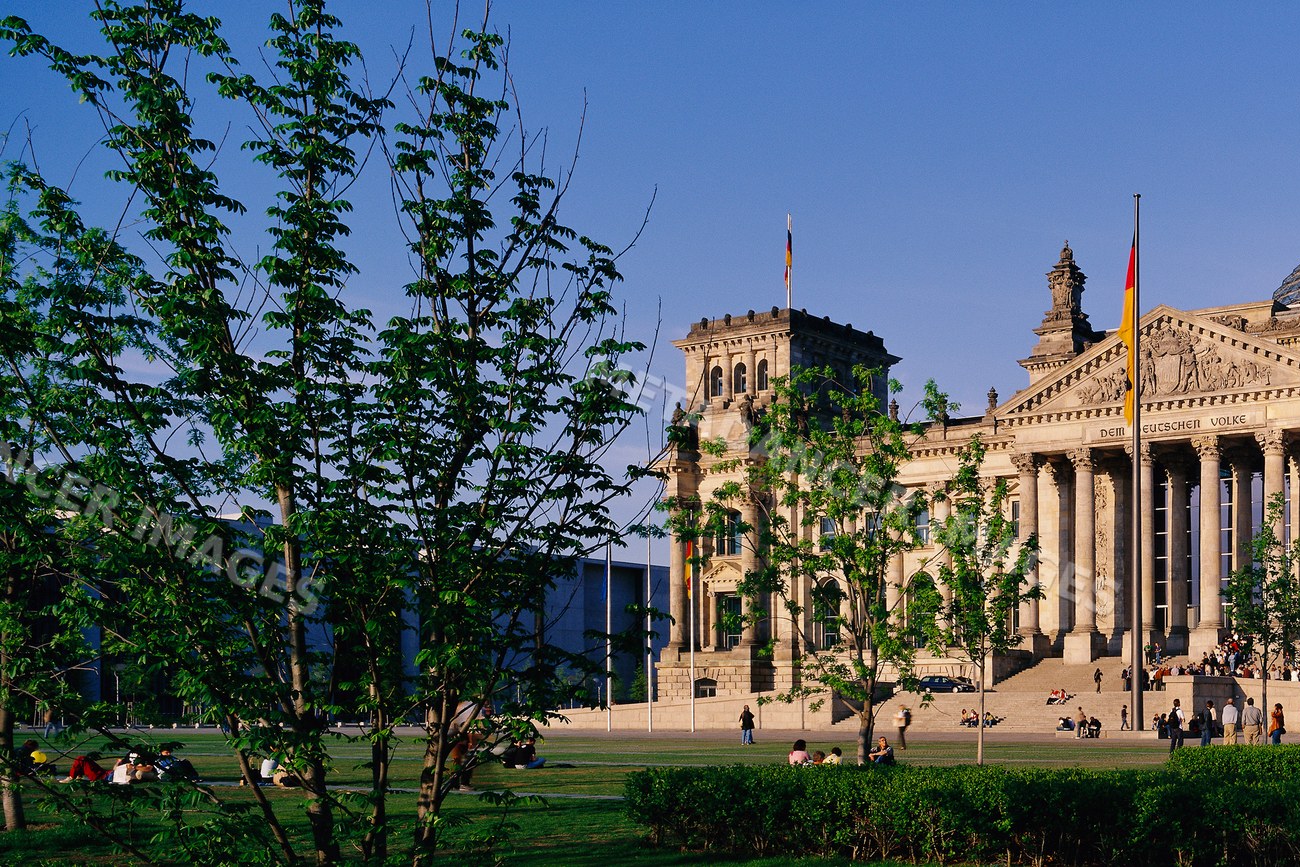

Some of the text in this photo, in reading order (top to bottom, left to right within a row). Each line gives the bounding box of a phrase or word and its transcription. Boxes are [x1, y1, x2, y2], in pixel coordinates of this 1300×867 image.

[1100, 414, 1247, 438] DEM EUTSCHEN VOLKE
